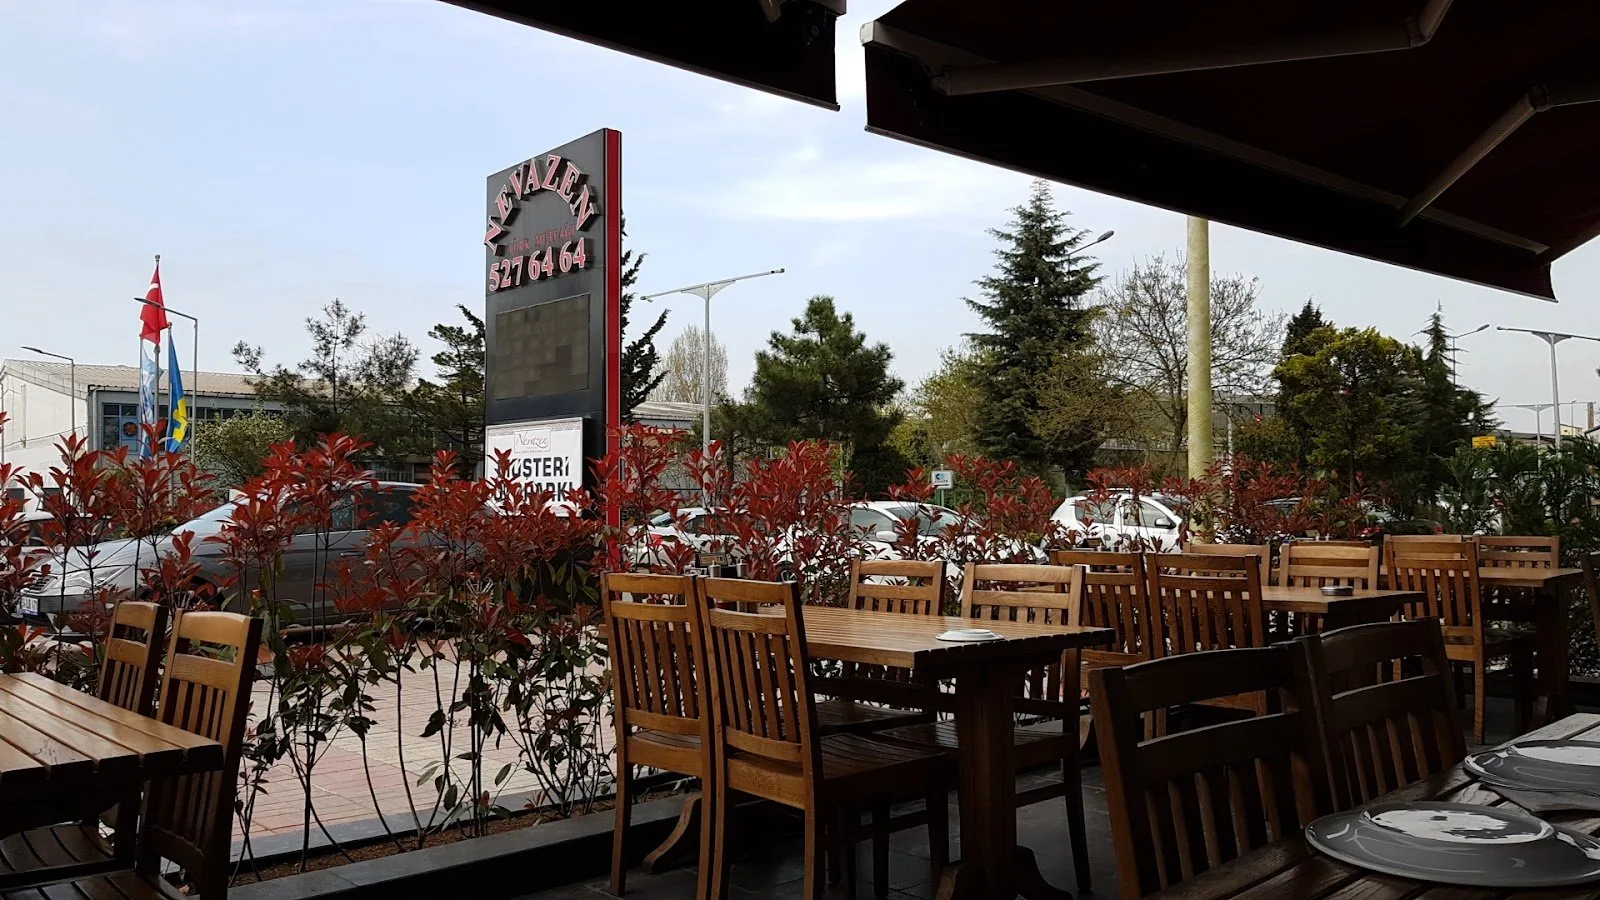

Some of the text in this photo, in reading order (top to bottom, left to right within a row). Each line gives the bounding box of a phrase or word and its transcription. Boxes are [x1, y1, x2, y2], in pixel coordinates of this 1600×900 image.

[484, 154, 596, 255] NEVAZEN
[488, 237, 586, 292] 527 64 64
